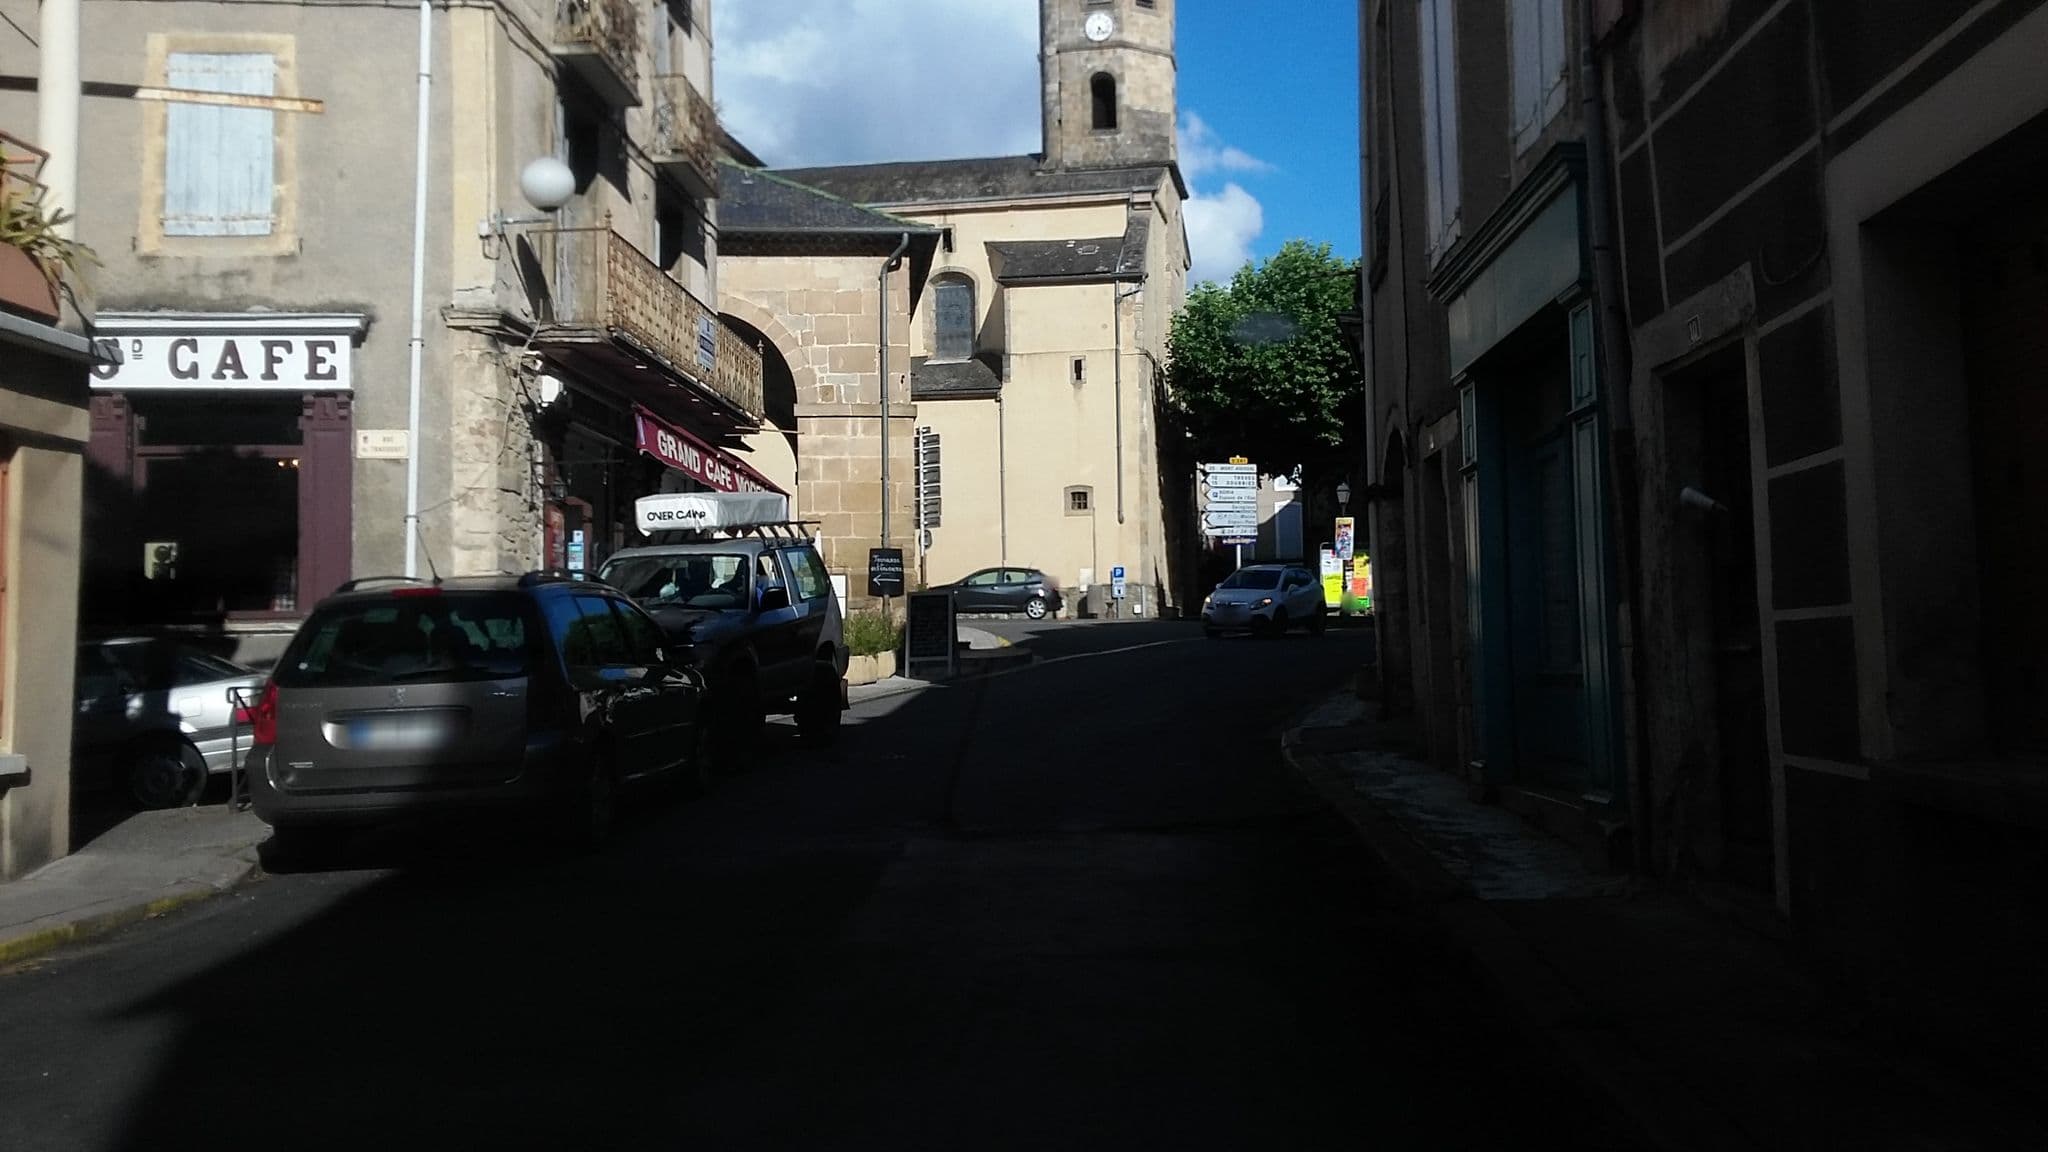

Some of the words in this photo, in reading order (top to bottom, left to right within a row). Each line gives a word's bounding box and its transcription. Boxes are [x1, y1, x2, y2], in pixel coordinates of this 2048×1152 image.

[168, 337, 337, 380] CAFE
[657, 429, 701, 474] GRAND
[705, 457, 733, 490] CAFE
[646, 511, 674, 521] OVER
[676, 509, 706, 520] CAMP
